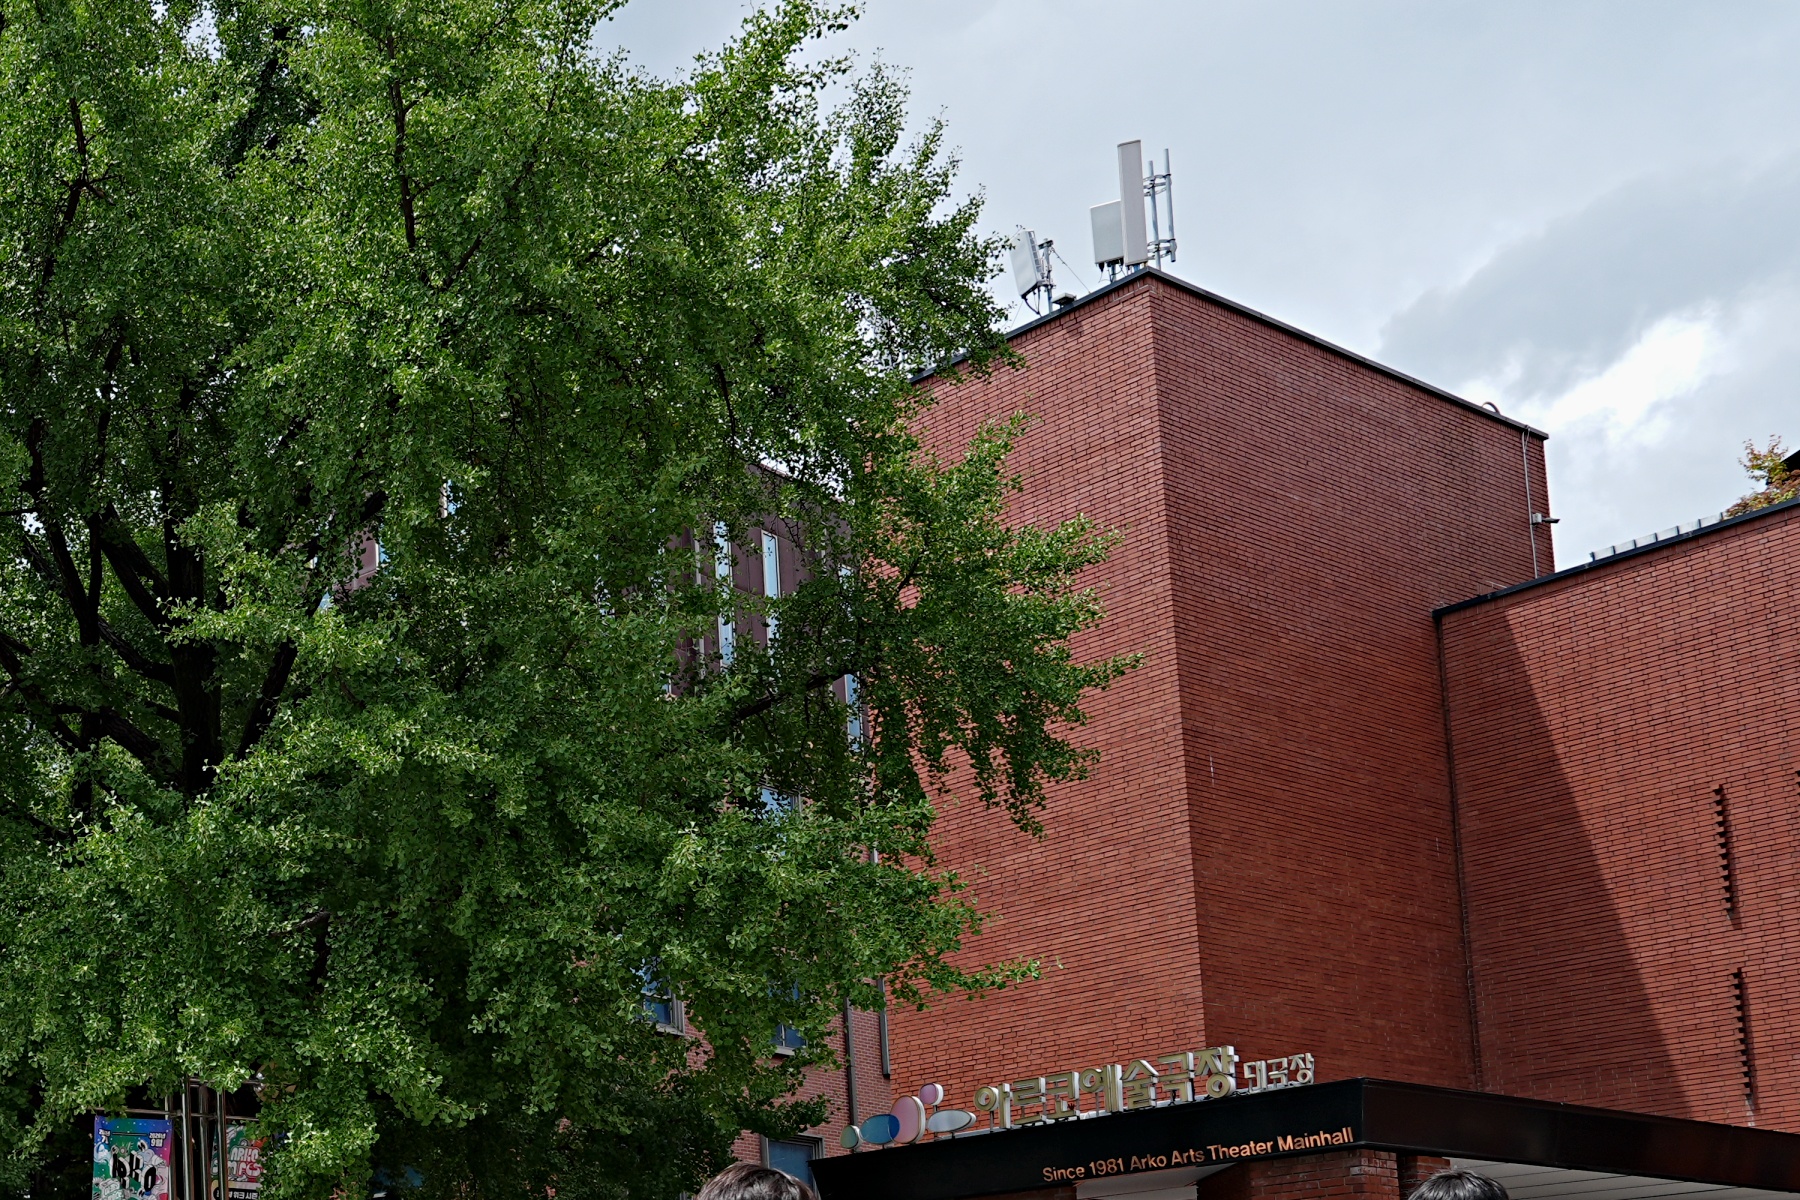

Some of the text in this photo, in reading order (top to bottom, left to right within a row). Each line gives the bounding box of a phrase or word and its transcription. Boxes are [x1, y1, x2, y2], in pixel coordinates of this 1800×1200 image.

[974, 1045, 1314, 1129] 아르코예술극장 대극장
[1042, 1126, 1354, 1182] Since 1981 Arko Arts Theater Mainhall
